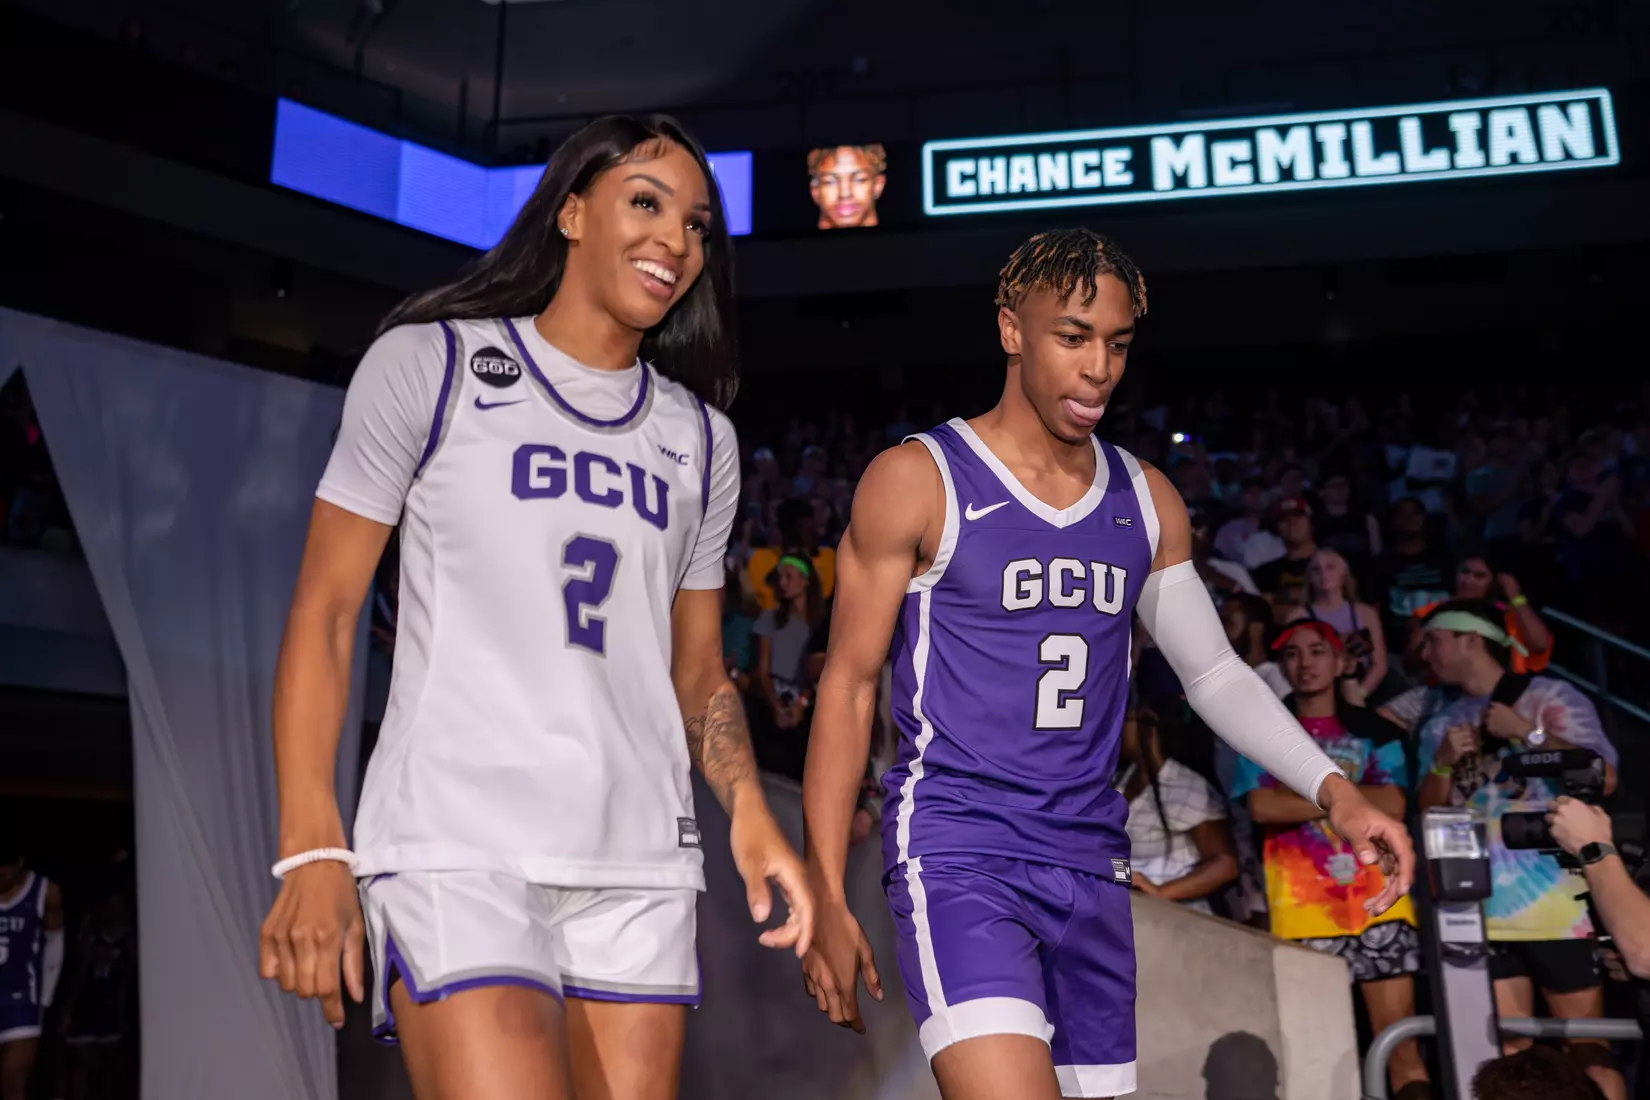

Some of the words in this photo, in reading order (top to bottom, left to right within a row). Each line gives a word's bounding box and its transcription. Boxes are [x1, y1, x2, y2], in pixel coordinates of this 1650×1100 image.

[946, 148, 1132, 197] CHANCE
[473, 361, 520, 376] GOD
[511, 443, 669, 532] GCU
[560, 531, 623, 659] 2
[1001, 557, 1128, 617] GCU
[1033, 632, 1090, 732] 2
